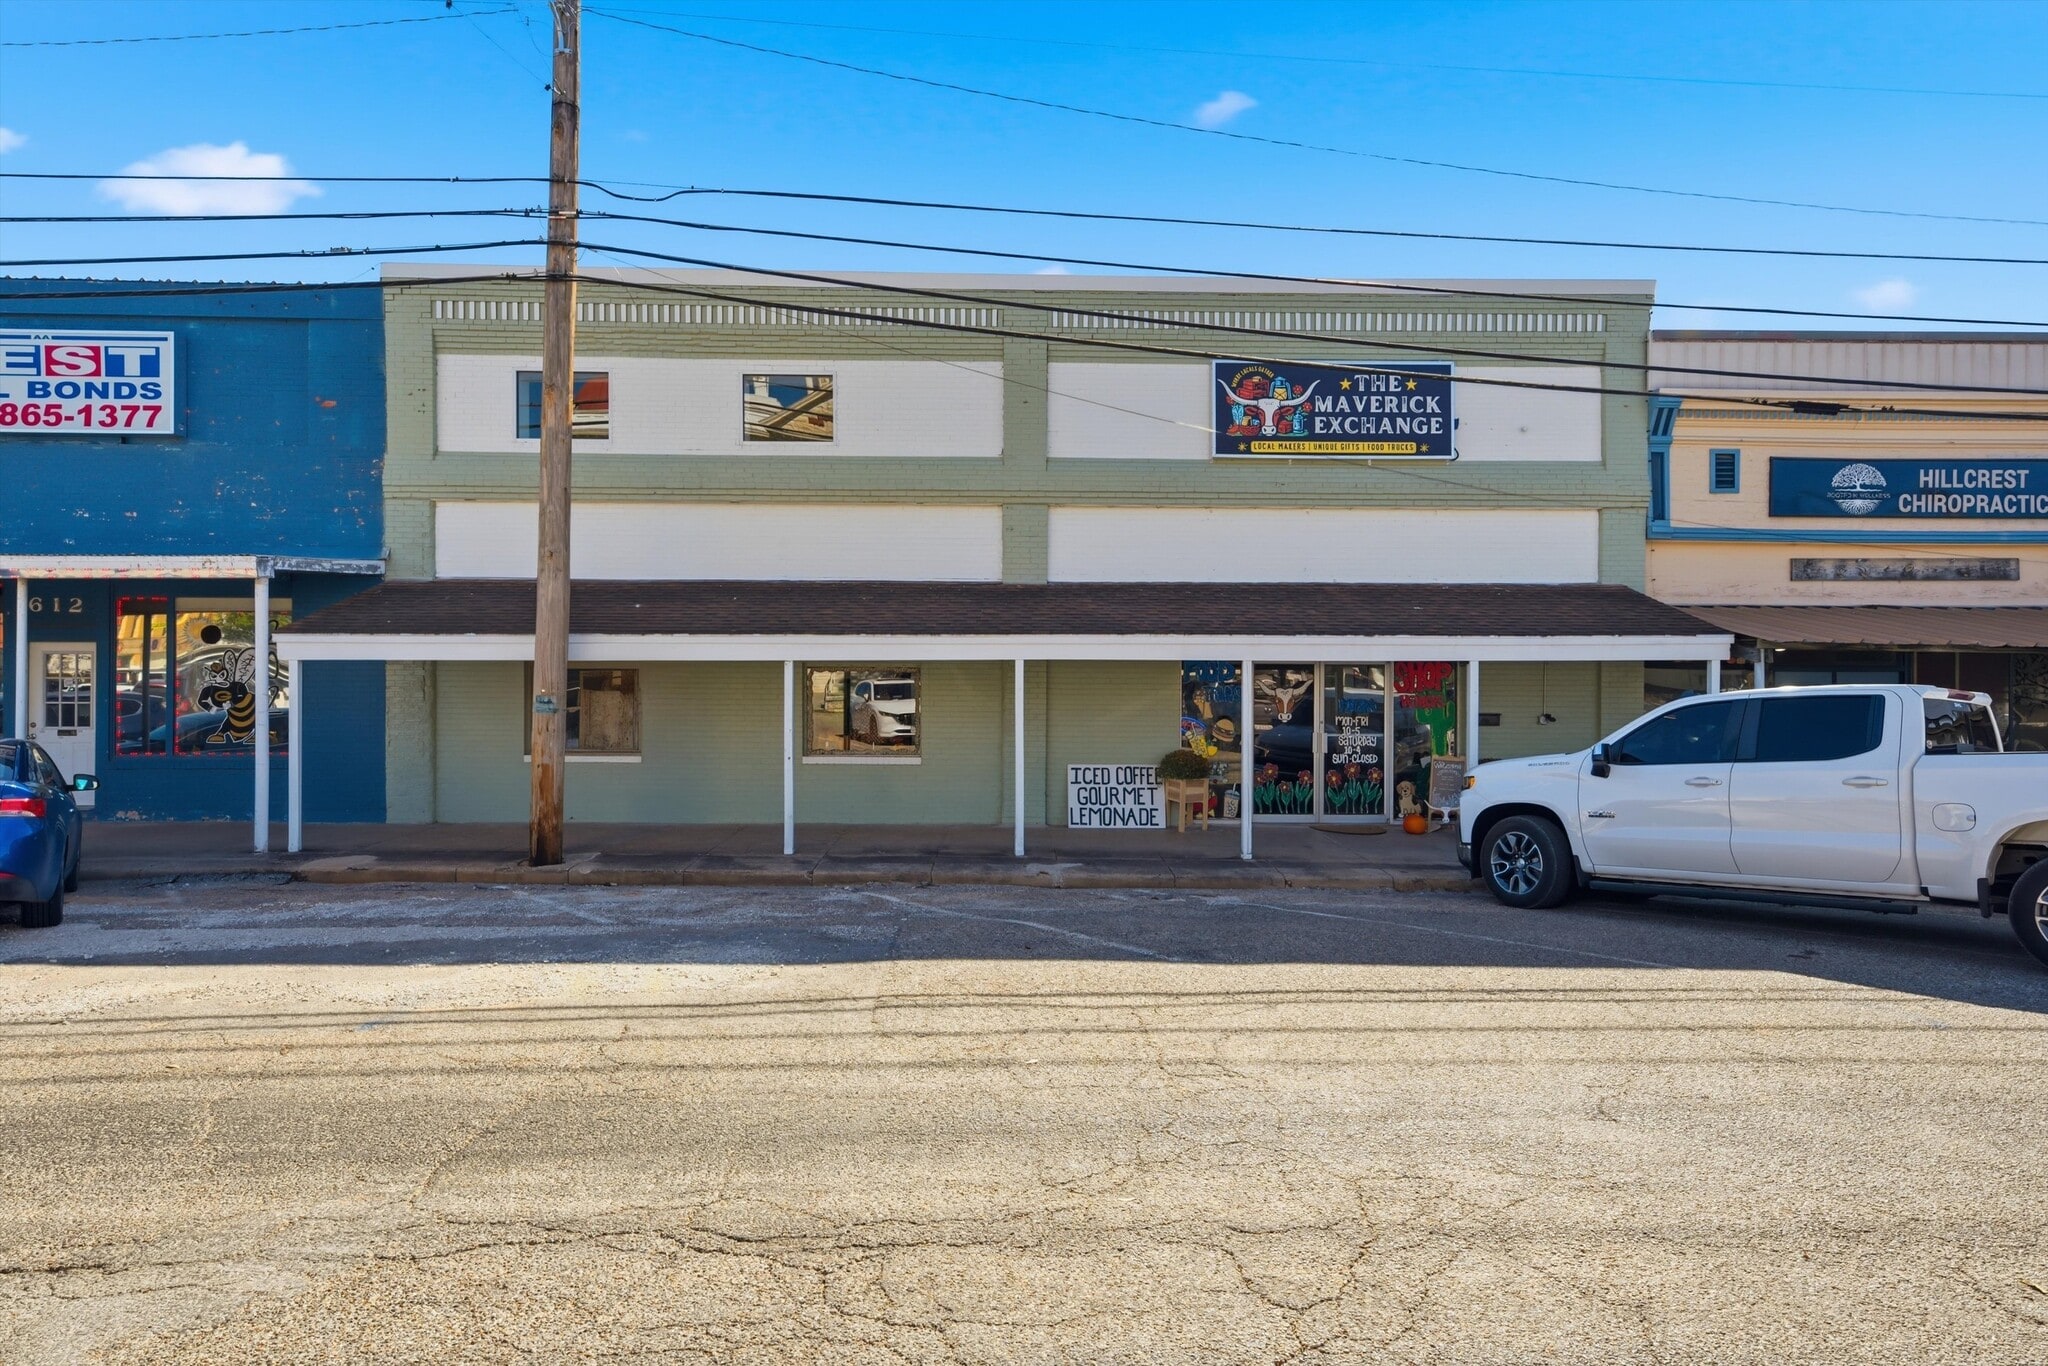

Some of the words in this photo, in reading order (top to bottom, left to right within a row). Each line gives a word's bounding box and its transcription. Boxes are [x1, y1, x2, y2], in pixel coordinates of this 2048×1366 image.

[27, 381, 162, 400] BONDS
[1354, 374, 1402, 391] THE
[1315, 395, 1442, 413] MAVERICK
[0, 403, 162, 428] 865-1377
[1314, 416, 1444, 434] EXCHANGE
[1367, 443, 1385, 451] FOOD
[1387, 443, 1414, 451] TRUCKS
[1919, 469, 2030, 489] HILLCREST
[1898, 494, 2048, 513] CHIROPRACTIC
[29, 597, 83, 613] 612
[1394, 661, 1452, 692] SHOP
[1342, 726, 1361, 736] 10-5
[1344, 746, 1361, 755] 10-4
[1070, 767, 1110, 785] ICED
[1115, 766, 1163, 785] COFFEE
[1077, 786, 1158, 806] GOURMET
[1070, 807, 1159, 826] LEMONADE
